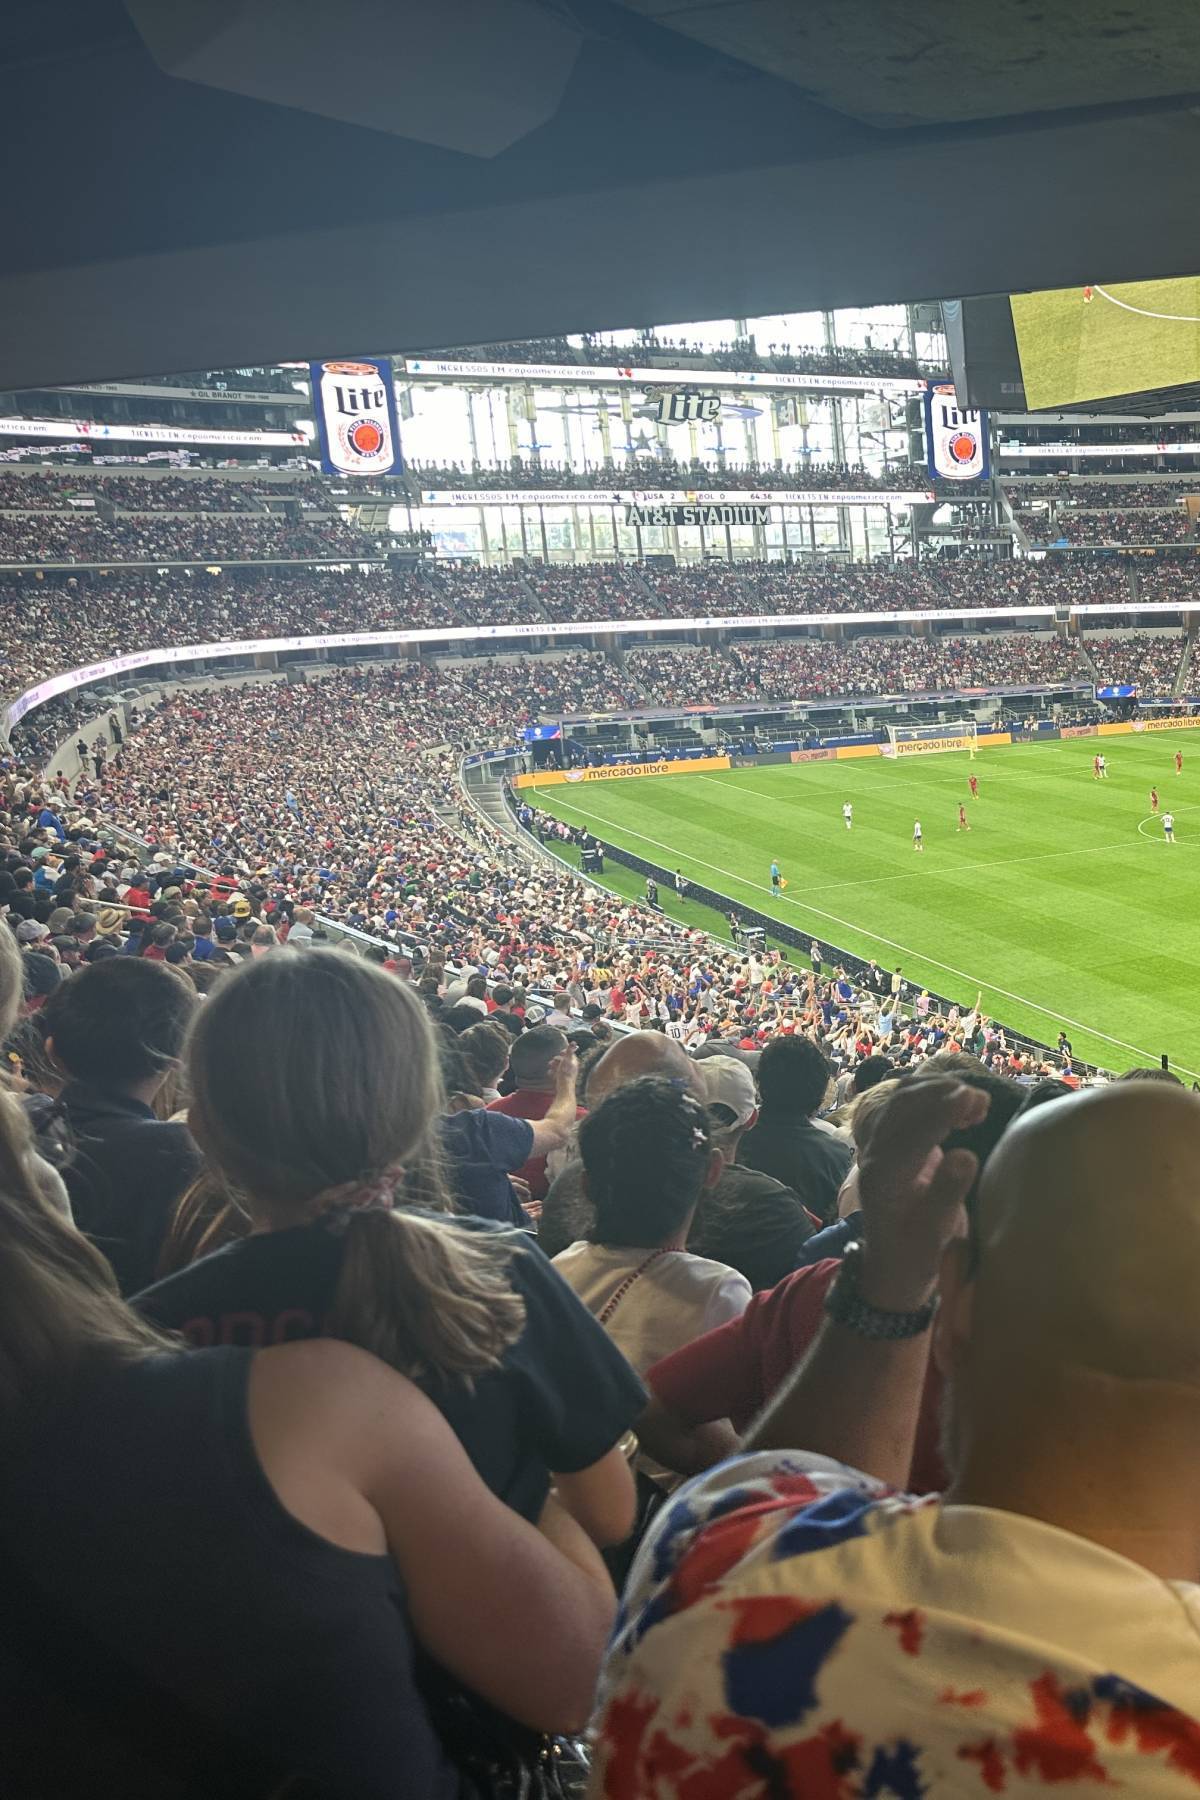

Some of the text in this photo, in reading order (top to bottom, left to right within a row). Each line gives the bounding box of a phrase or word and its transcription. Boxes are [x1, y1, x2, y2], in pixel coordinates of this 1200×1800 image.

[211, 391, 242, 400] BRANDT
[333, 385, 384, 417] Lite
[656, 392, 722, 426] Lite
[627, 505, 772, 527] AT&T STADIUM
[1147, 718, 1200, 730] mercado libre
[897, 738, 963, 754] mercado libre
[588, 763, 669, 780] mercado libre
[670, 1028, 681, 1039] 10
